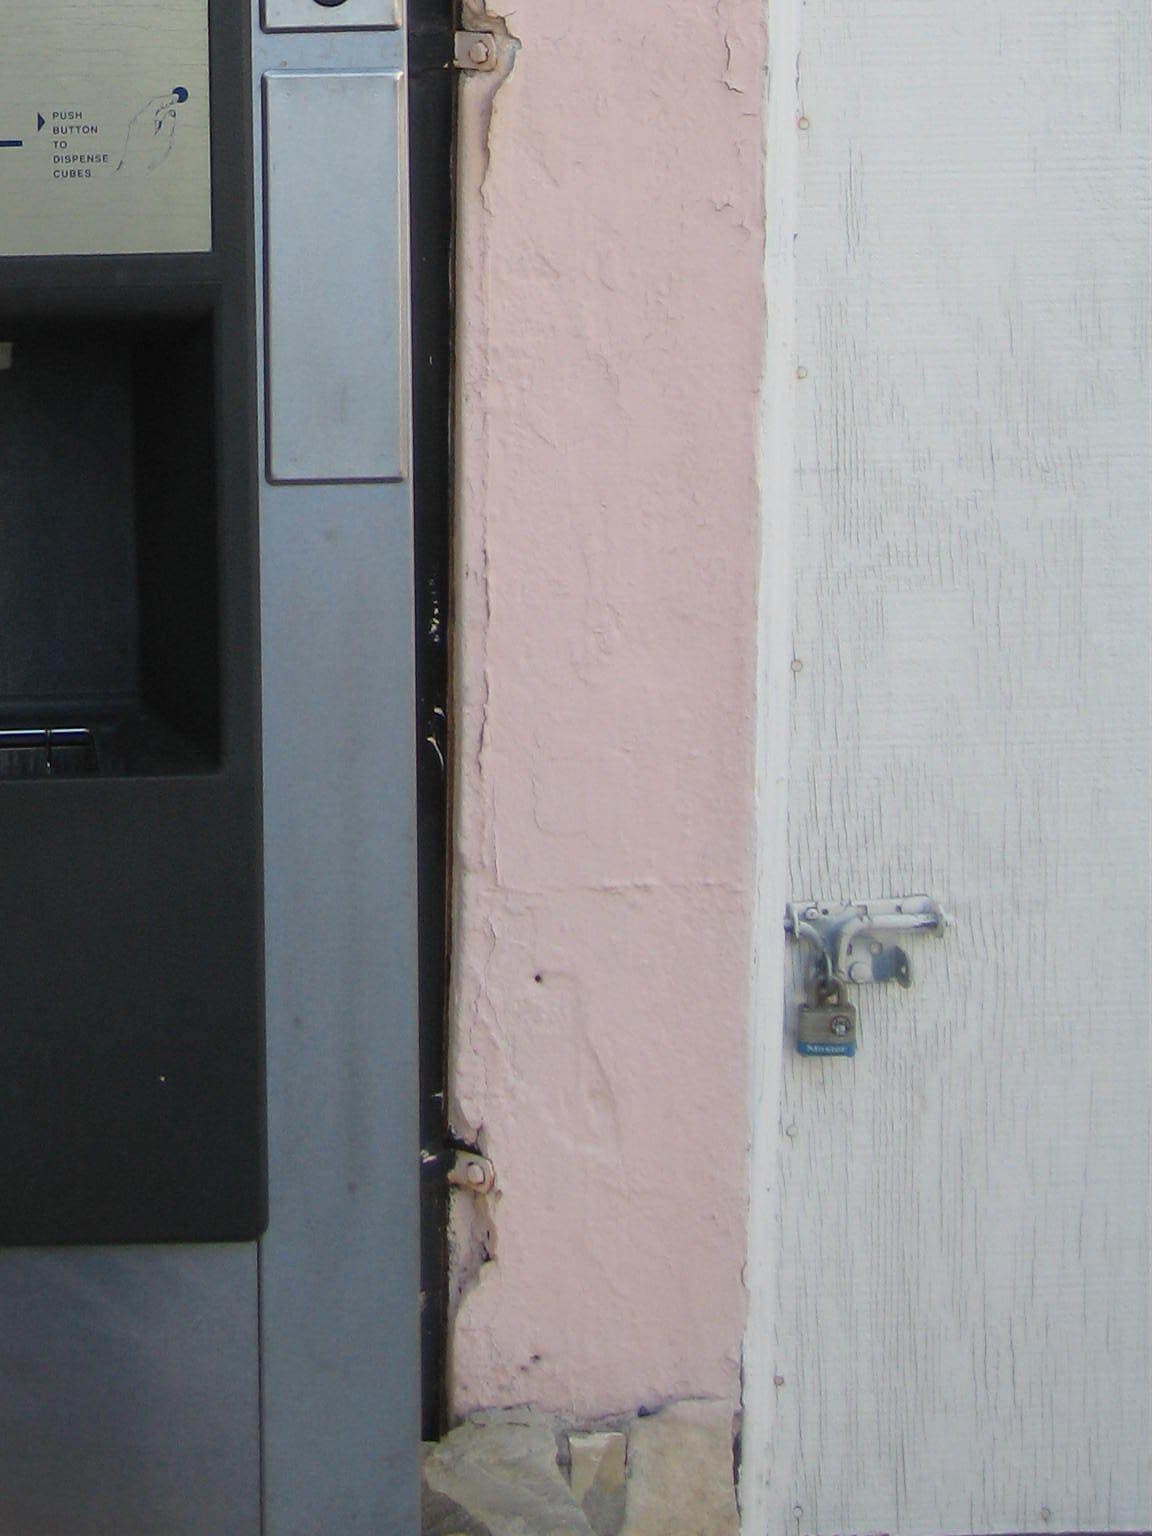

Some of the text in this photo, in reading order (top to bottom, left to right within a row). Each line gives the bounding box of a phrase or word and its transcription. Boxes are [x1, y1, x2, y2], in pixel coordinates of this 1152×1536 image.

[52, 111, 83, 120] PUSH
[52, 125, 98, 135] BUTTON
[53, 140, 68, 149] TO
[53, 154, 109, 164] DISPENSE
[53, 169, 92, 178] CUBES
